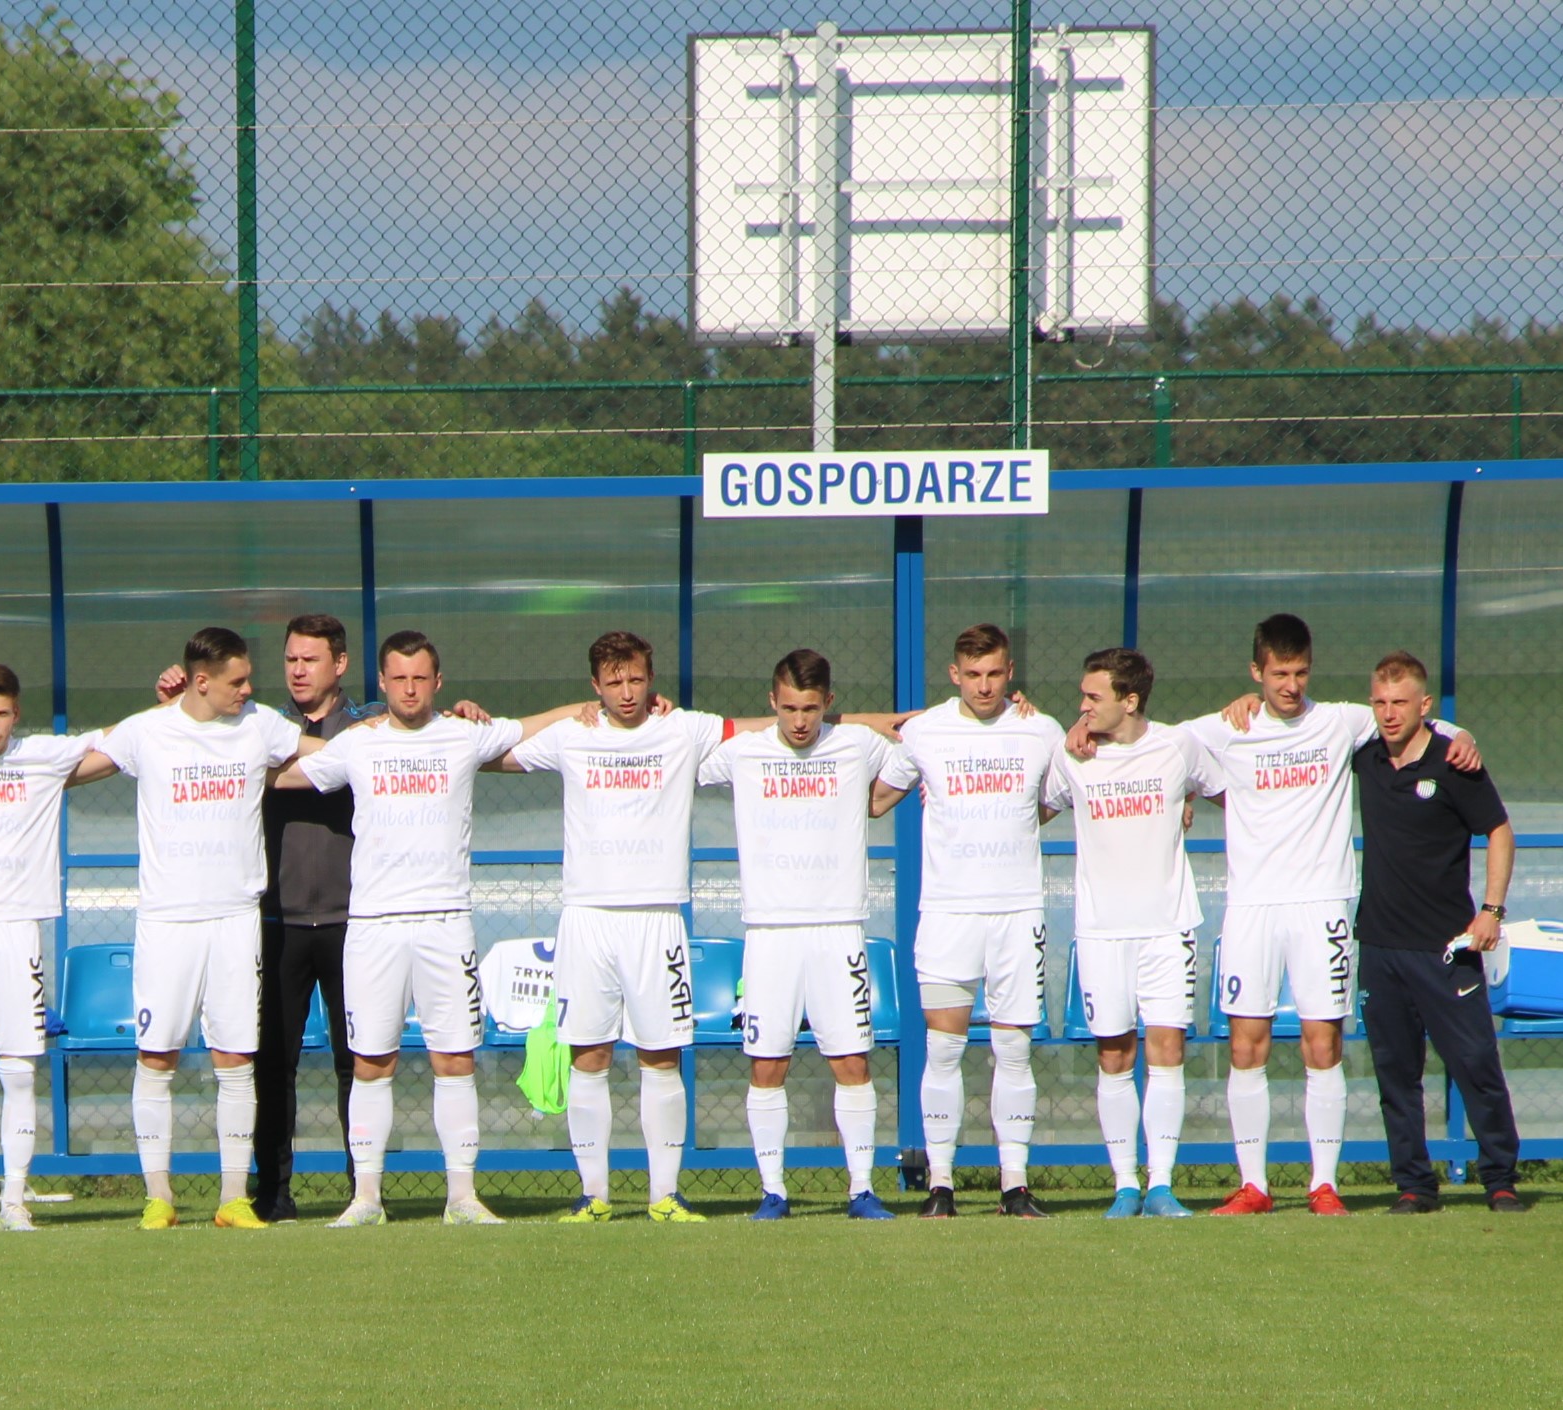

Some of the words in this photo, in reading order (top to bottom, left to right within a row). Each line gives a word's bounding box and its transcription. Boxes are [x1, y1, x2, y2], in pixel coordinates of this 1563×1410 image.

[720, 460, 1032, 506] GOSPODARZE
[373, 760, 384, 774] TY
[384, 756, 400, 773] TEŻ
[401, 758, 448, 773] PRACUJESZ
[587, 756, 598, 768] TY
[599, 754, 614, 768] TEŻ
[615, 754, 663, 768] PRACUJESZ
[762, 762, 772, 776] TY
[773, 758, 789, 776] TEŻ
[791, 760, 836, 776] PRACUJESZ
[945, 760, 956, 774] TY
[957, 756, 974, 773] TEŻ
[976, 757, 1024, 773] PRACUJESZ
[1255, 754, 1267, 768] TY
[1266, 751, 1282, 767] TEŻ
[1283, 747, 1329, 766] PRACUJESZ
[172, 768, 183, 781] TY
[184, 763, 199, 780] TEŻ
[201, 762, 246, 779] PRACUJESZ
[586, 769, 602, 790] ZA
[605, 769, 651, 790] DARMO
[653, 769, 663, 790] ?!
[1256, 769, 1271, 790] ZA
[1273, 765, 1318, 789] DARMO
[1320, 763, 1329, 784] ?!
[17, 782, 27, 802] ?!
[173, 783, 188, 803] ZA
[191, 778, 236, 801] DARMO
[237, 778, 246, 799] ?!
[373, 775, 388, 796] ZA
[391, 774, 437, 795] DARMO
[439, 773, 449, 794] ?!
[763, 777, 778, 798] ZA
[781, 776, 827, 798] DARMO
[829, 776, 838, 797] ?!
[947, 774, 964, 796] ZA
[965, 772, 1013, 795] DARMO
[1015, 772, 1024, 793] ?!
[1086, 784, 1097, 798] TY
[1097, 780, 1113, 797] TEŻ
[1114, 778, 1163, 795] PRACUJESZ
[1088, 799, 1105, 820] ZA
[1106, 794, 1152, 819] DARMO
[1155, 794, 1164, 815] ?!
[557, 998, 569, 1028] 7
[1083, 991, 1095, 1022] 5
[138, 1007, 152, 1038] 9
[923, 1112, 949, 1120] JAKO
[1008, 1114, 1036, 1122] JAKO
[226, 1132, 255, 1140] JAKO
